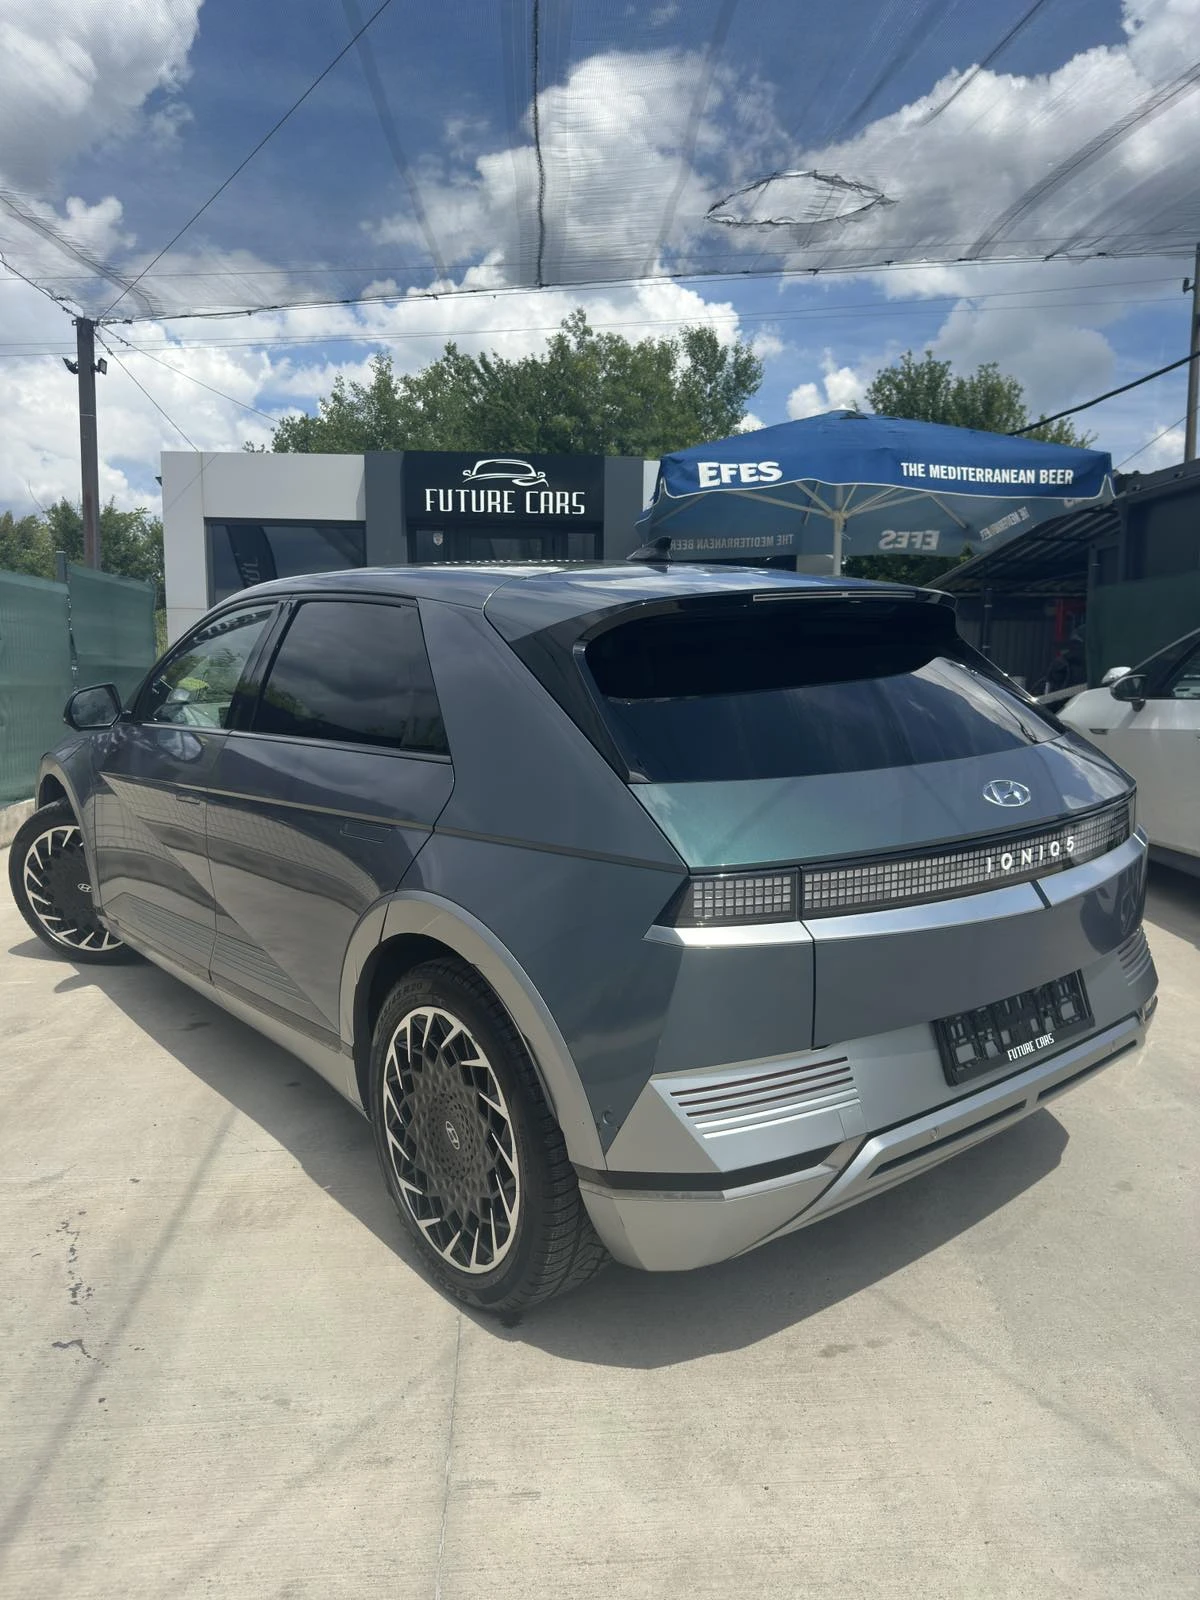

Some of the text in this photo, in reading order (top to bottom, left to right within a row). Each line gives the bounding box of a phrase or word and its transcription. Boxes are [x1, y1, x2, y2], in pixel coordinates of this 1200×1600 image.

[697, 461, 783, 488] EFES
[901, 462, 1074, 484] THE MEDITERRANEAN BEER
[425, 488, 586, 515] FUTURE CARS
[1007, 1032, 1055, 1061] FUTURE CARS
